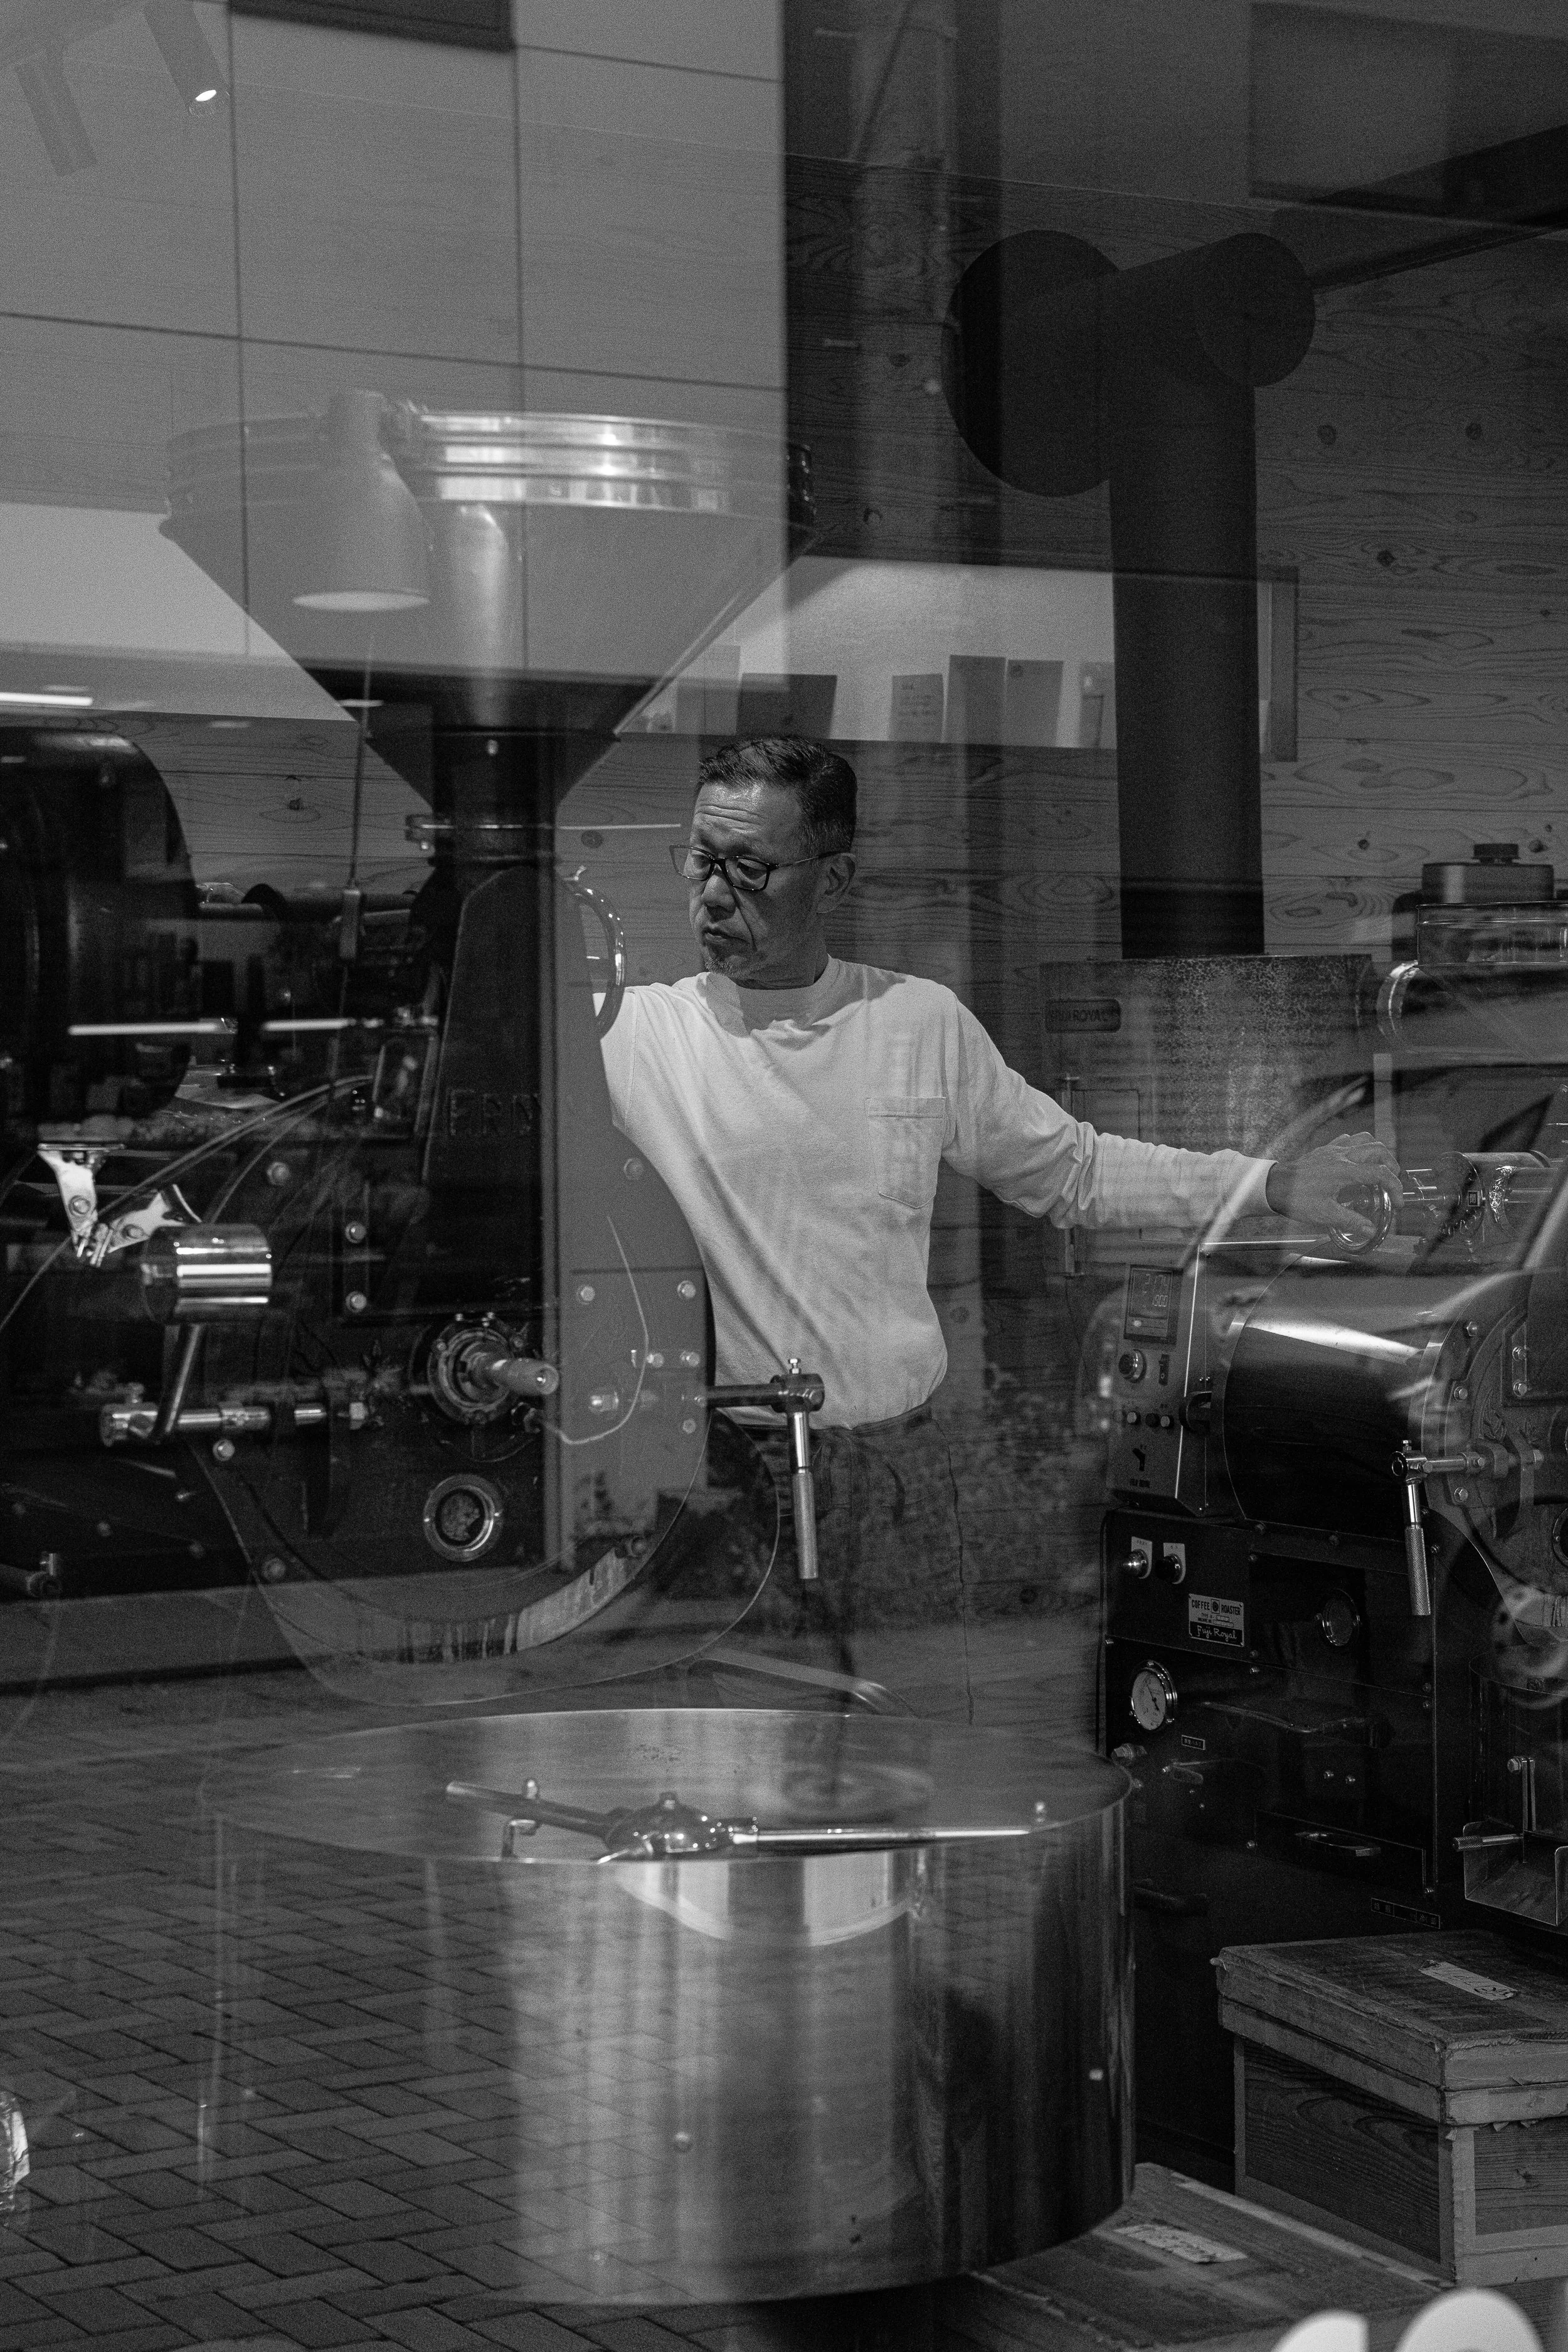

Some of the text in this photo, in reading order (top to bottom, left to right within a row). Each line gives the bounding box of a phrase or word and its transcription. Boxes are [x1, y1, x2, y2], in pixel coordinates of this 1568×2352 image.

[1191, 1599, 1241, 1615] COFFEE ROASTER
[1197, 1625, 1237, 1642] Fuji Royal
